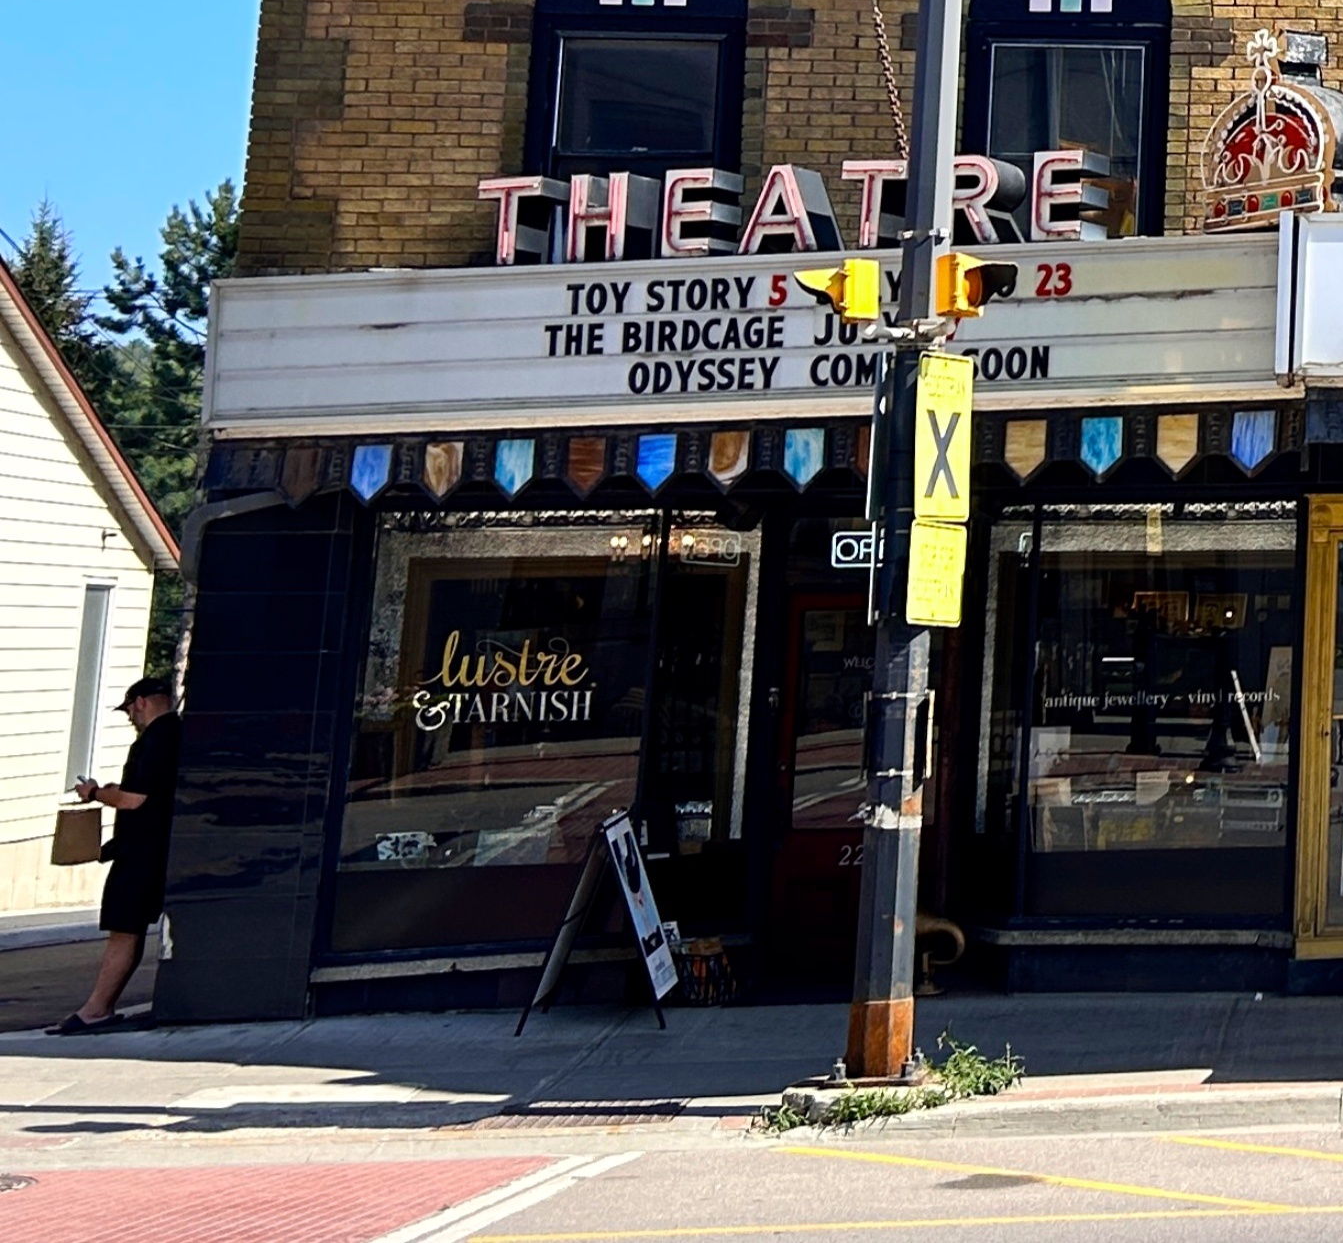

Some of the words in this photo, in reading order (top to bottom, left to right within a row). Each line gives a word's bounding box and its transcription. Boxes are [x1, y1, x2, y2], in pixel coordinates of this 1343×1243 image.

[477, 149, 1084, 265] THEATRE
[566, 281, 632, 316] TOY
[646, 276, 756, 313] STORY
[768, 274, 788, 307] 5
[1035, 262, 1073, 297] 23
[545, 322, 605, 357] THE
[622, 315, 786, 354] BIRDCAGE
[627, 356, 781, 395] ODYSSEY
[418, 629, 590, 688] lustre
[412, 689, 450, 732] &
[450, 690, 593, 724] TARNISH
[1044, 692, 1100, 712] antique
[1102, 689, 1170, 710] jewellery
[1187, 689, 1223, 708] vinyl
[1227, 687, 1281, 704] records
